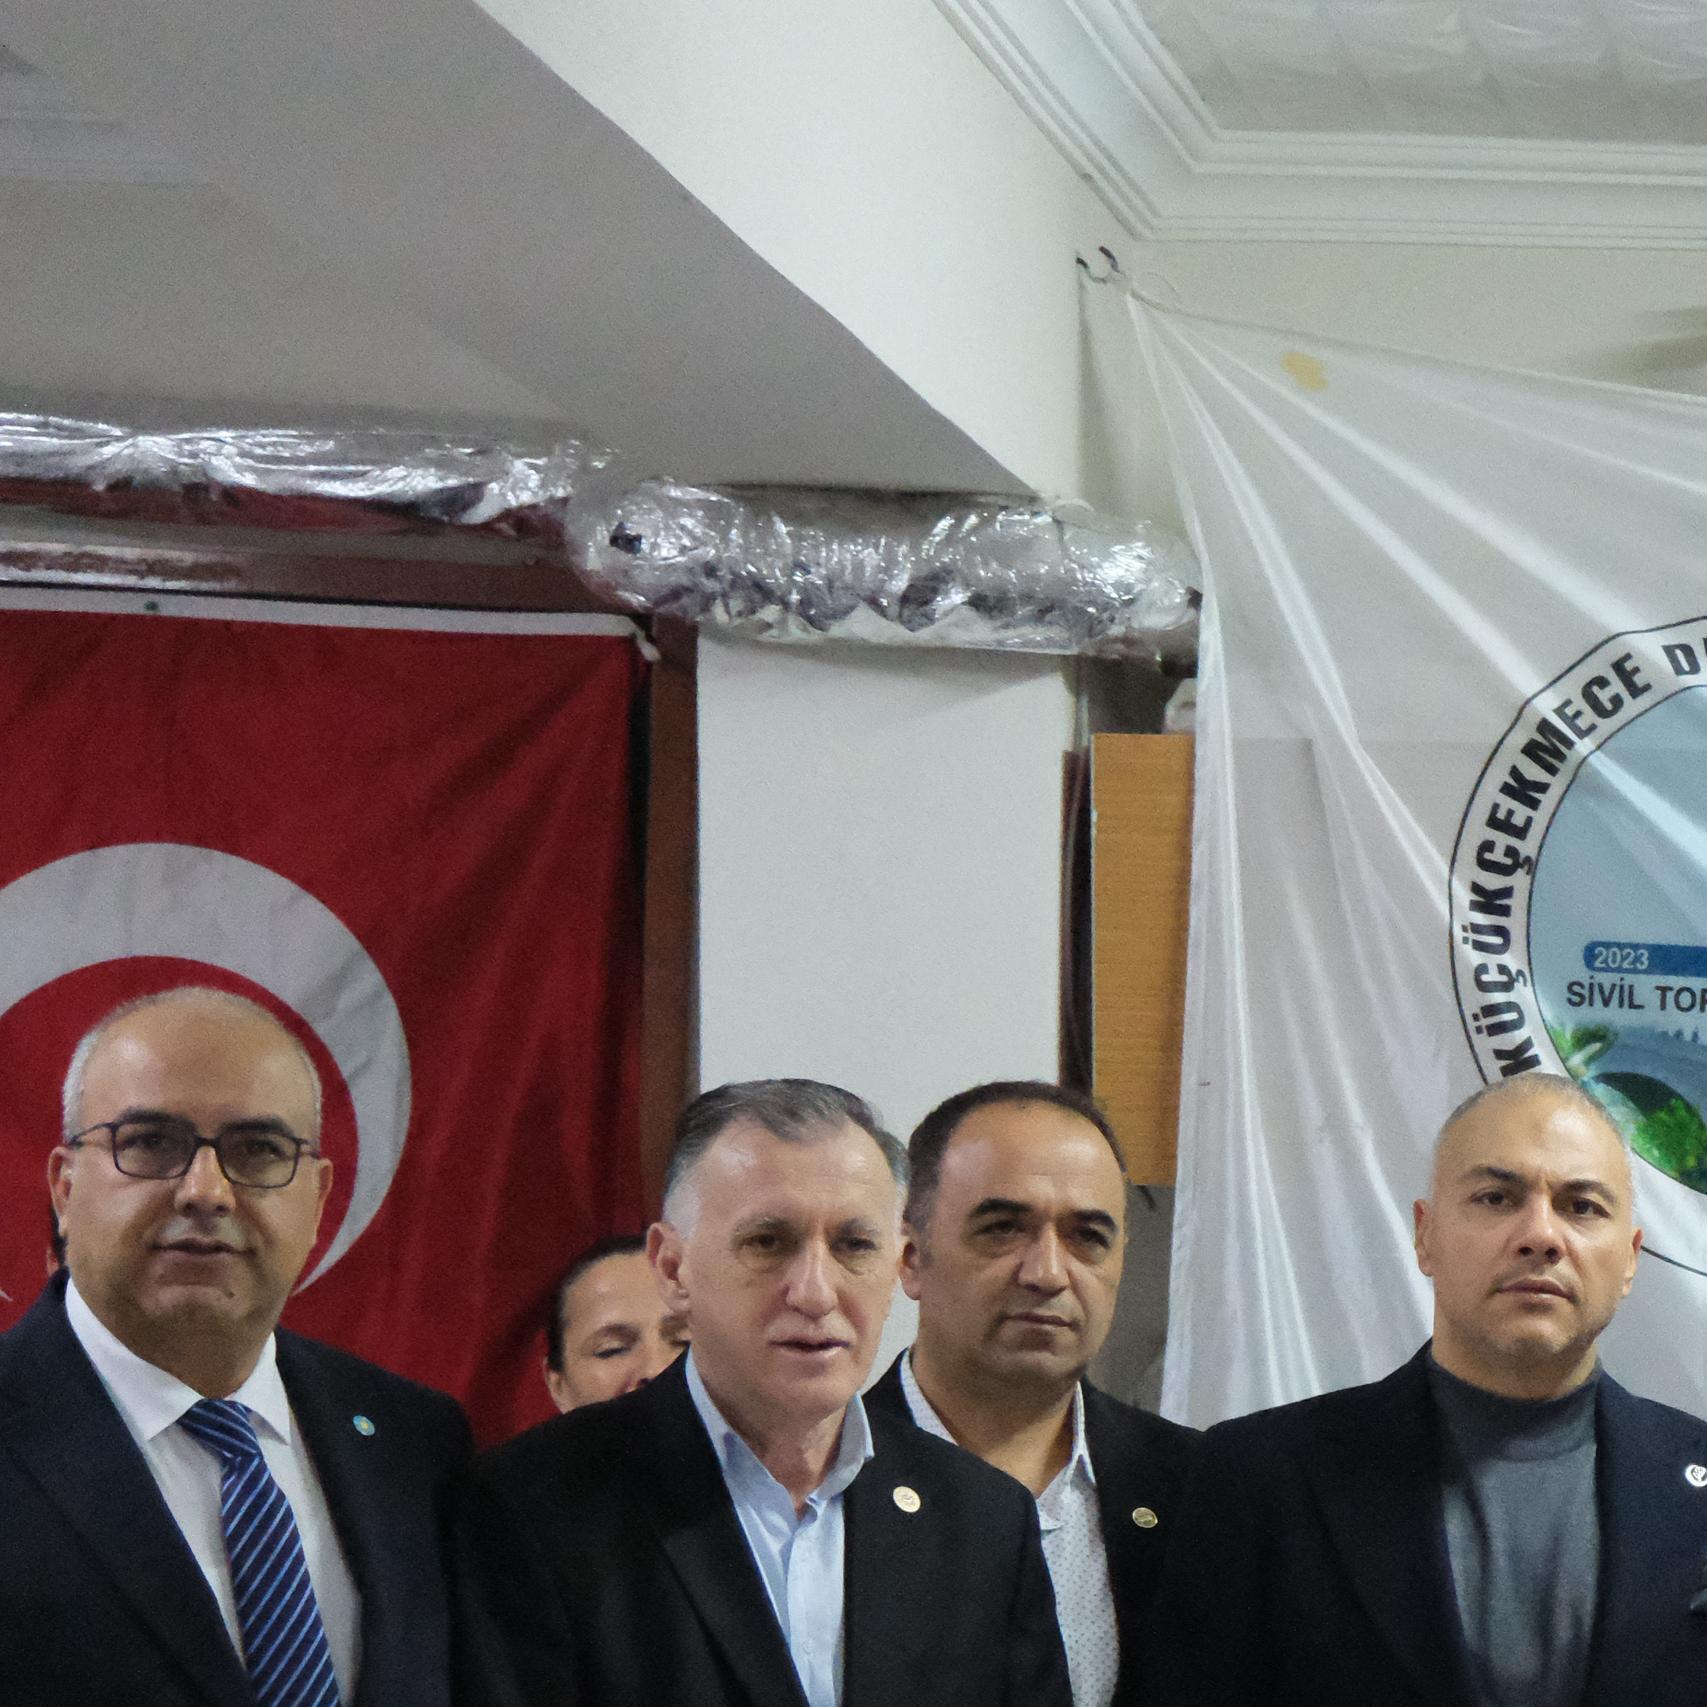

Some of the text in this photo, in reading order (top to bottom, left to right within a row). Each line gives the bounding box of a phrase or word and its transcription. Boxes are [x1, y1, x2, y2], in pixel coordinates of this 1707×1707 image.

[1461, 652, 1653, 1077] KÜÇÜKÇEKMECE
[1594, 947, 1650, 970] 2023
[1566, 976, 1646, 1011] SİVİL
